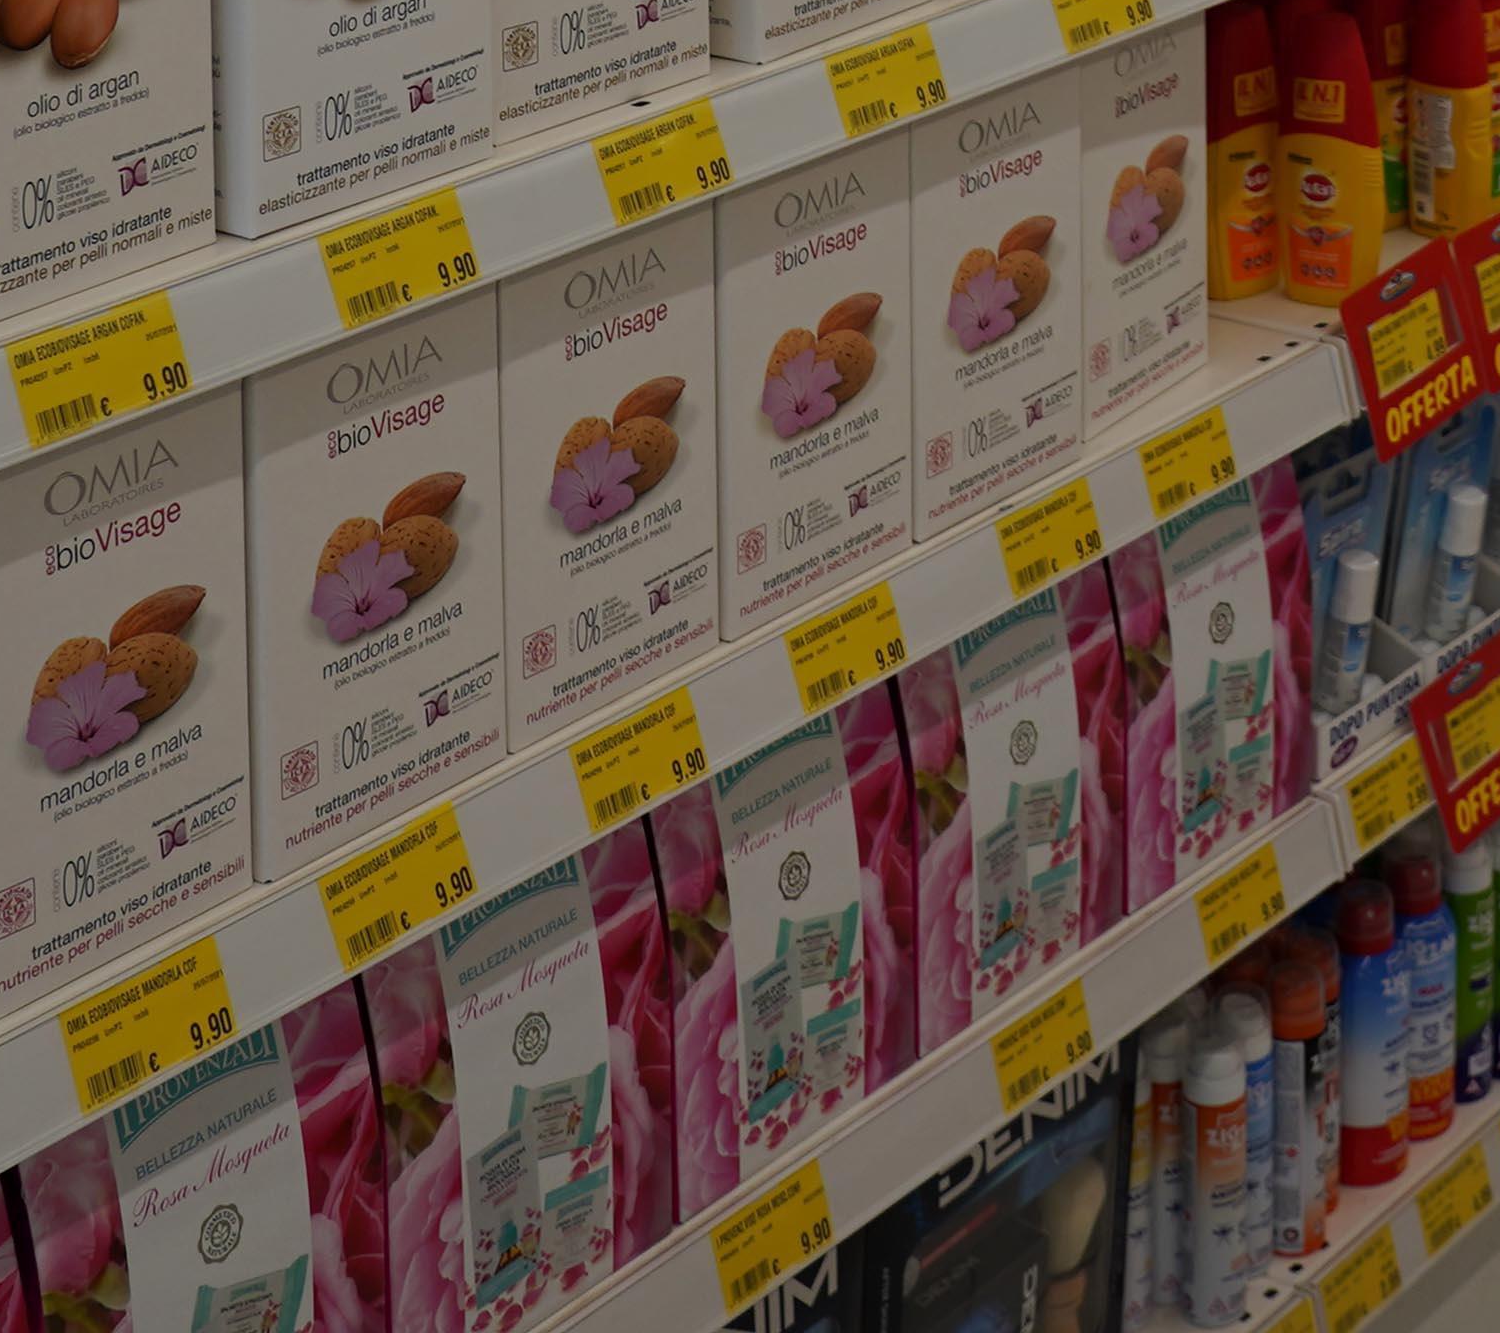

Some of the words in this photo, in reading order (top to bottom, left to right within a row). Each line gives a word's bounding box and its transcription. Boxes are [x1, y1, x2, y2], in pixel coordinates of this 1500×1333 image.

[57, 502, 181, 571] bioVisage
[135, 1131, 205, 1181] BELLEZZA
[206, 1087, 278, 1140] NATURALE
[131, 1183, 195, 1228] Rosa
